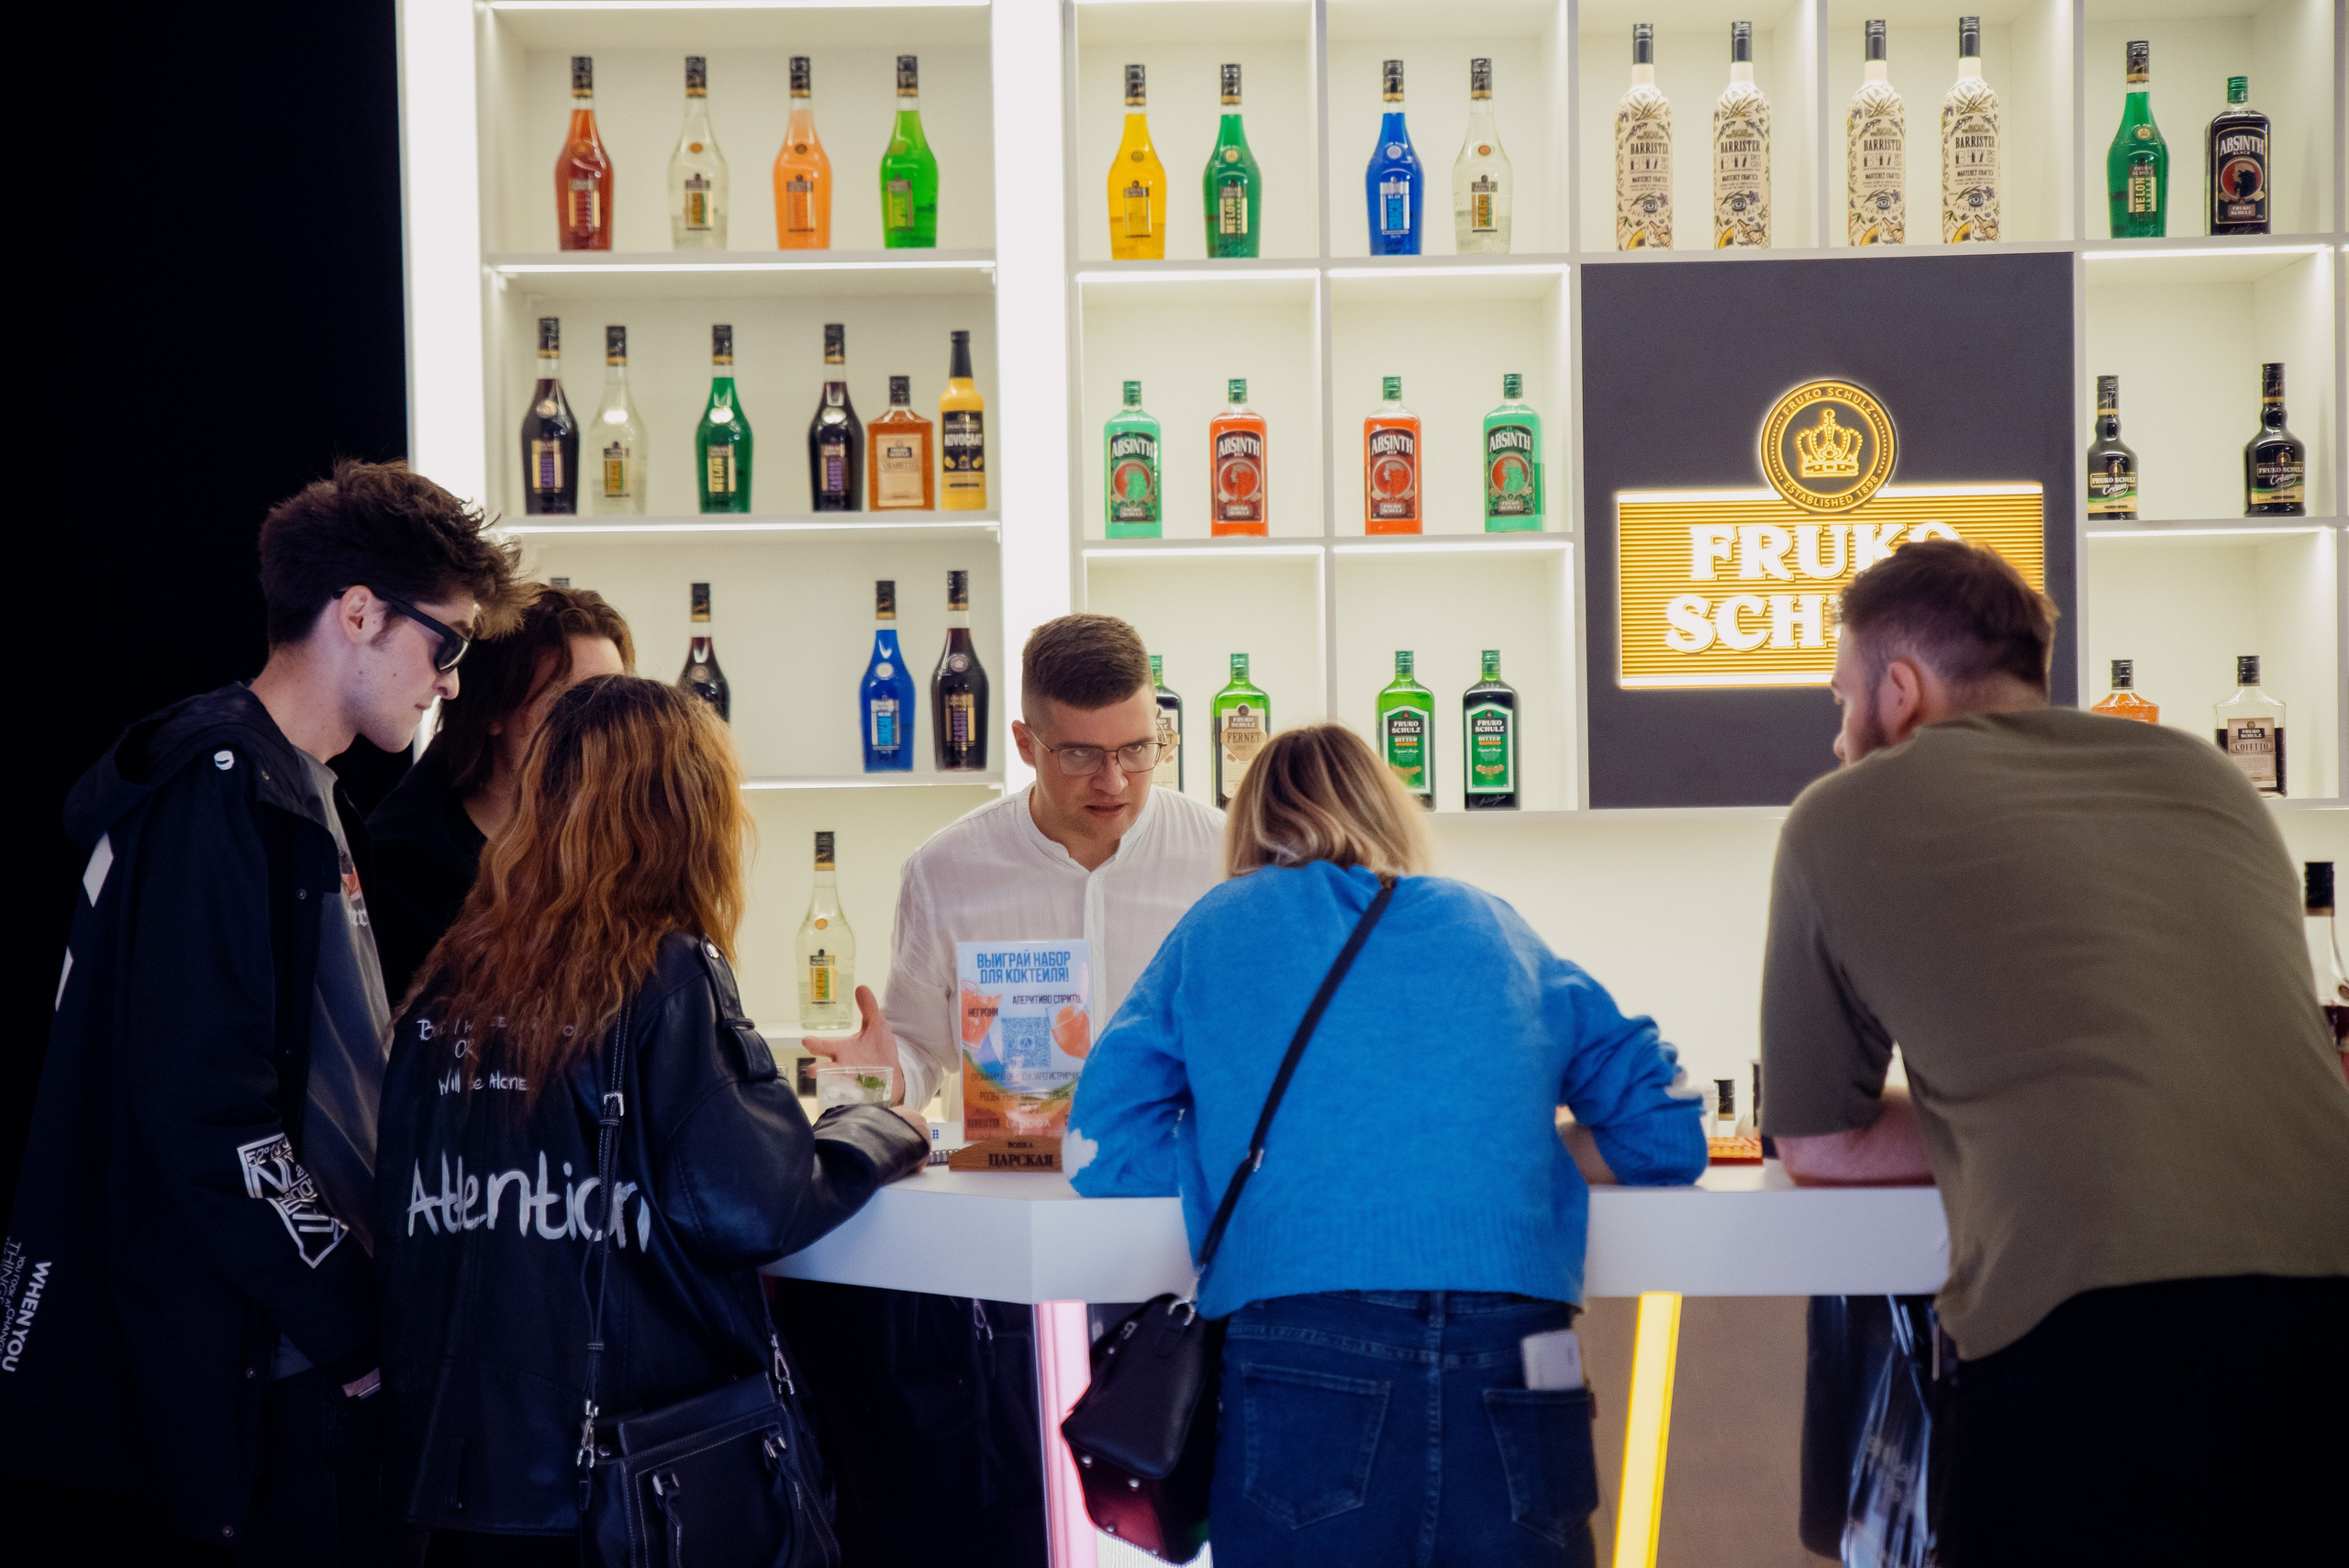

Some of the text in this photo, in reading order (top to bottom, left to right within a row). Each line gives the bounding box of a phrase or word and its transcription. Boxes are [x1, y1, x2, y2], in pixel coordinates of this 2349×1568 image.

[1631, 143, 1668, 154] BARRISTER
[1721, 140, 1760, 154] BARRISTER
[1864, 139, 1901, 151] BARRISTER
[1955, 136, 1995, 149] BARRISTER
[2220, 135, 2265, 156] ABSINTH
[2135, 177, 2145, 212] MELON
[1225, 198, 1235, 233] MELON
[1478, 195, 1488, 227] PEACH
[1782, 387, 1876, 415] FRUKO SCHULZ
[1111, 437, 1154, 458] ABSINTH
[1218, 437, 1261, 457] ABSINTH
[1371, 435, 1413, 455] ABSINTH
[1488, 432, 1531, 452] ABSINTH
[2270, 473, 2296, 484] Cream
[1784, 475, 1879, 507] ESTABLISHED 1898
[2103, 484, 2127, 495] Cream
[1227, 732, 1261, 743] FERNET
[2235, 743, 2269, 751] COFETTO
[977, 950, 1070, 969] ВЫИГРАЙ НАБОР
[980, 969, 1003, 984] ДЛЯ
[1013, 995, 1052, 1005] АПЕРИТИВО
[968, 1007, 998, 1017] НЕГРОНИ
[439, 1068, 461, 1095] Will
[989, 1154, 1053, 1169] ЦАРСКАЯ
[407, 1148, 651, 1253] Attention
[15, 1256, 26, 1273] YOU
[2, 1262, 52, 1373] WHEN YOU
